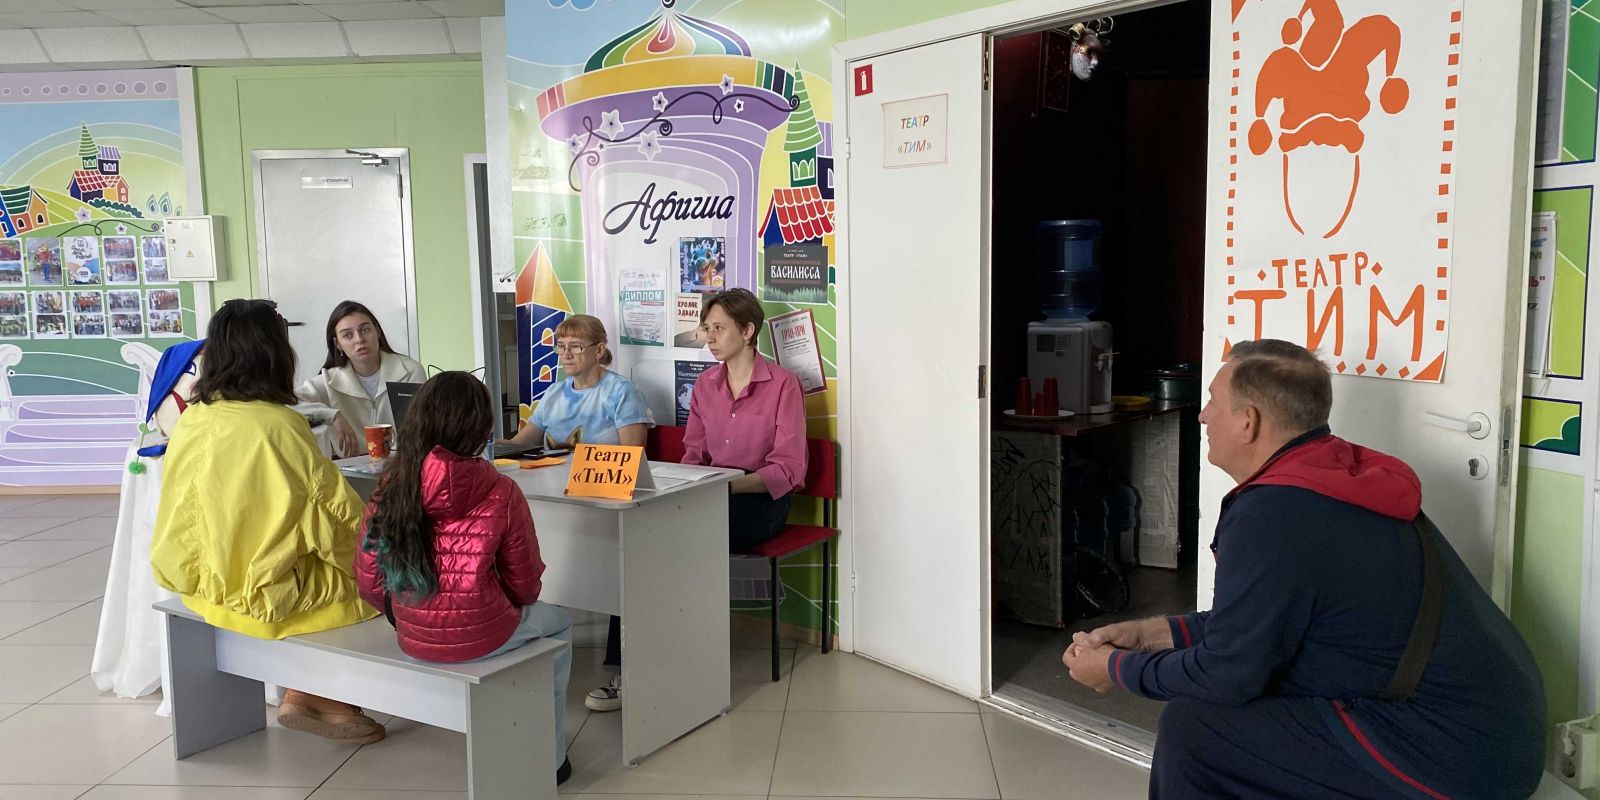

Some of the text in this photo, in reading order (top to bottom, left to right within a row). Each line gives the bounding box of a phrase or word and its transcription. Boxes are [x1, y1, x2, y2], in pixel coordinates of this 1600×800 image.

[900, 115, 930, 129] ТЕАТР
[897, 140, 932, 154] «ТИМ»
[602, 182, 736, 244] Афиша
[770, 265, 821, 280] ВАСИЛИССА
[1271, 251, 1369, 288] ТЕАТР
[624, 291, 662, 302] ДИПЛОМ
[1234, 284, 1425, 362] ТИМ
[584, 446, 632, 467] Театр
[572, 467, 633, 485] «ТиМ»
